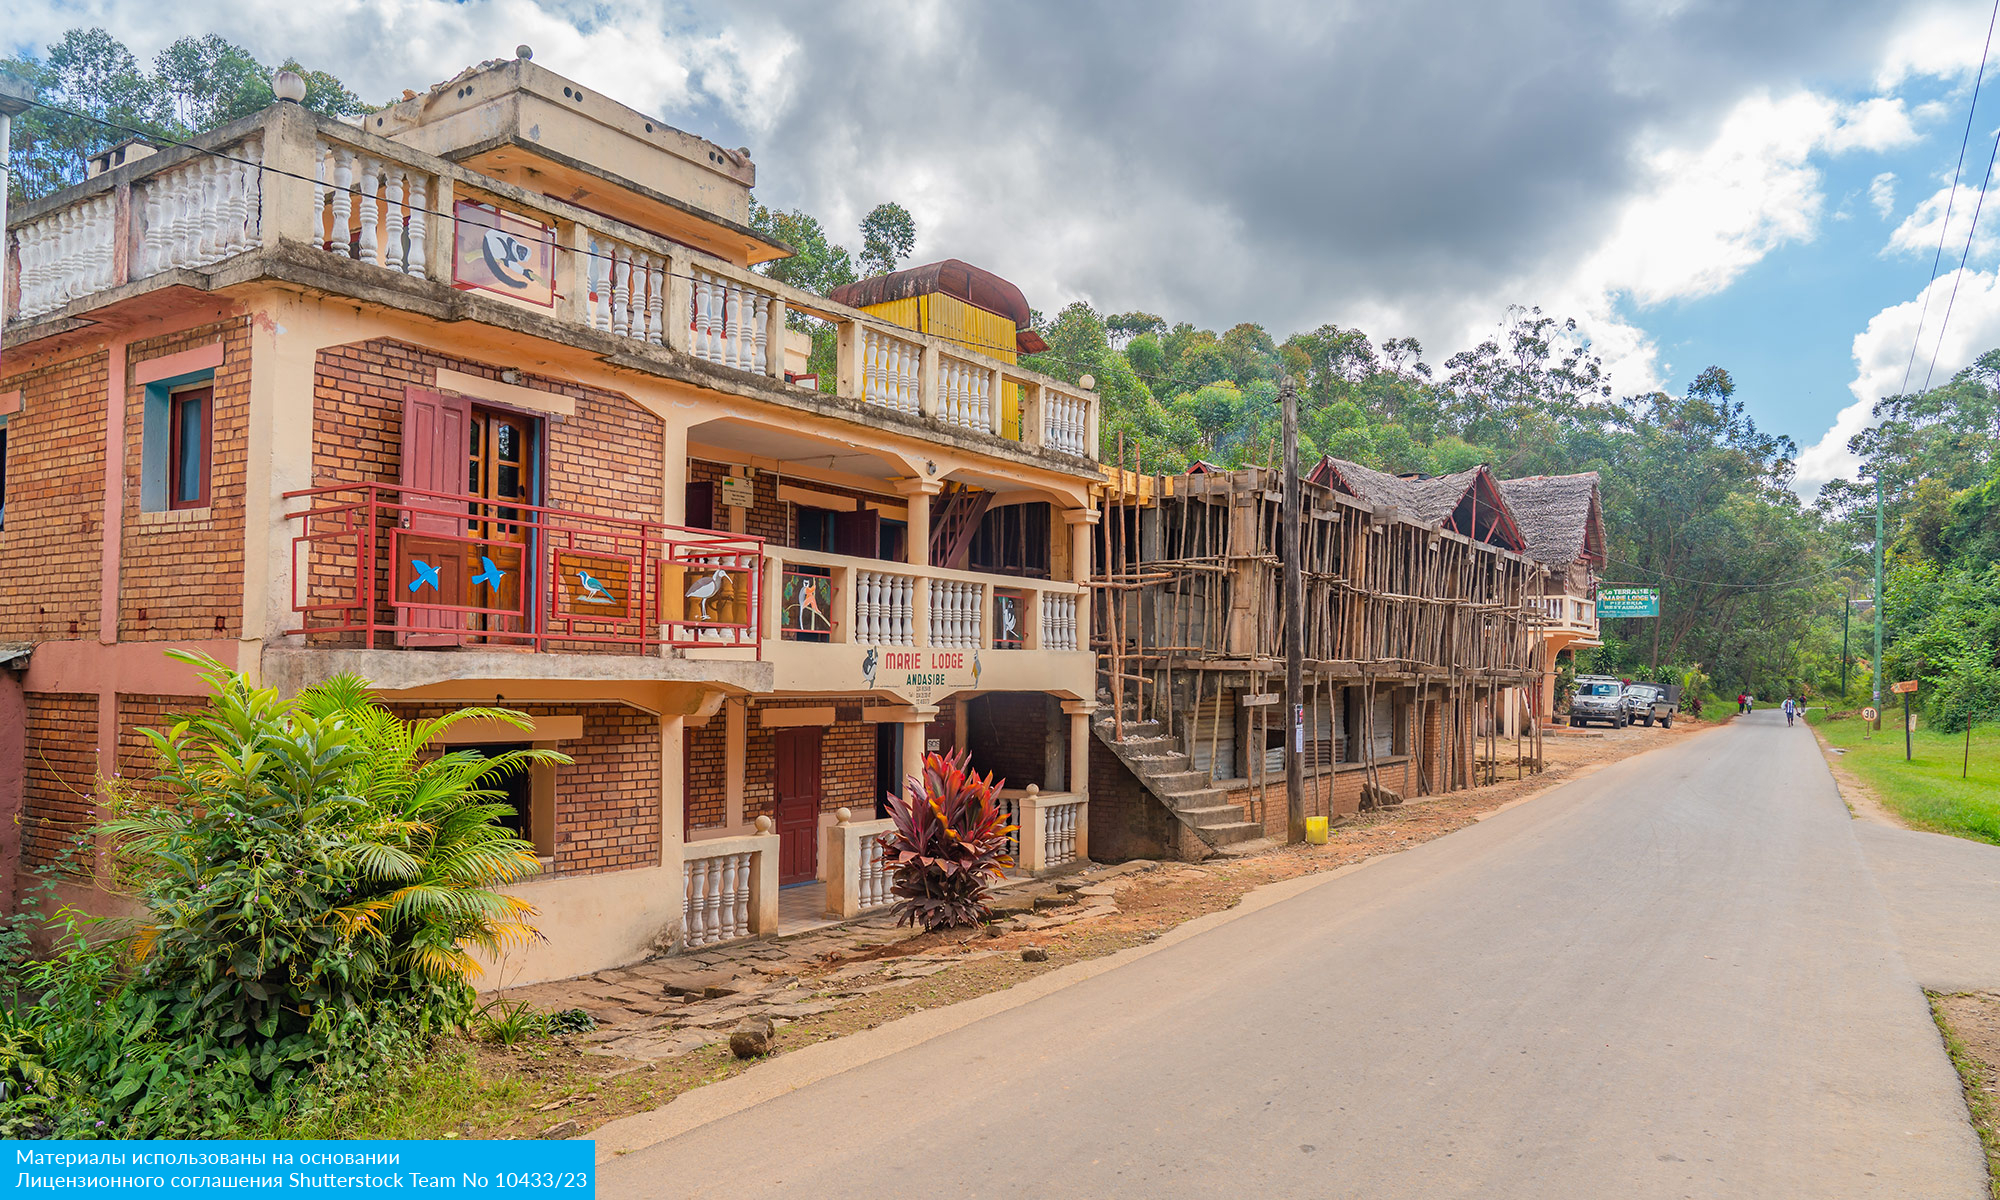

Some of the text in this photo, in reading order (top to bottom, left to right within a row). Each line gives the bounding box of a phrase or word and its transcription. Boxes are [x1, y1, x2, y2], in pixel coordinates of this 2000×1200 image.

[885, 652, 963, 670] MARIE LODGE
[906, 674, 945, 686] ANDASIBE
[1864, 709, 1875, 719] 30
